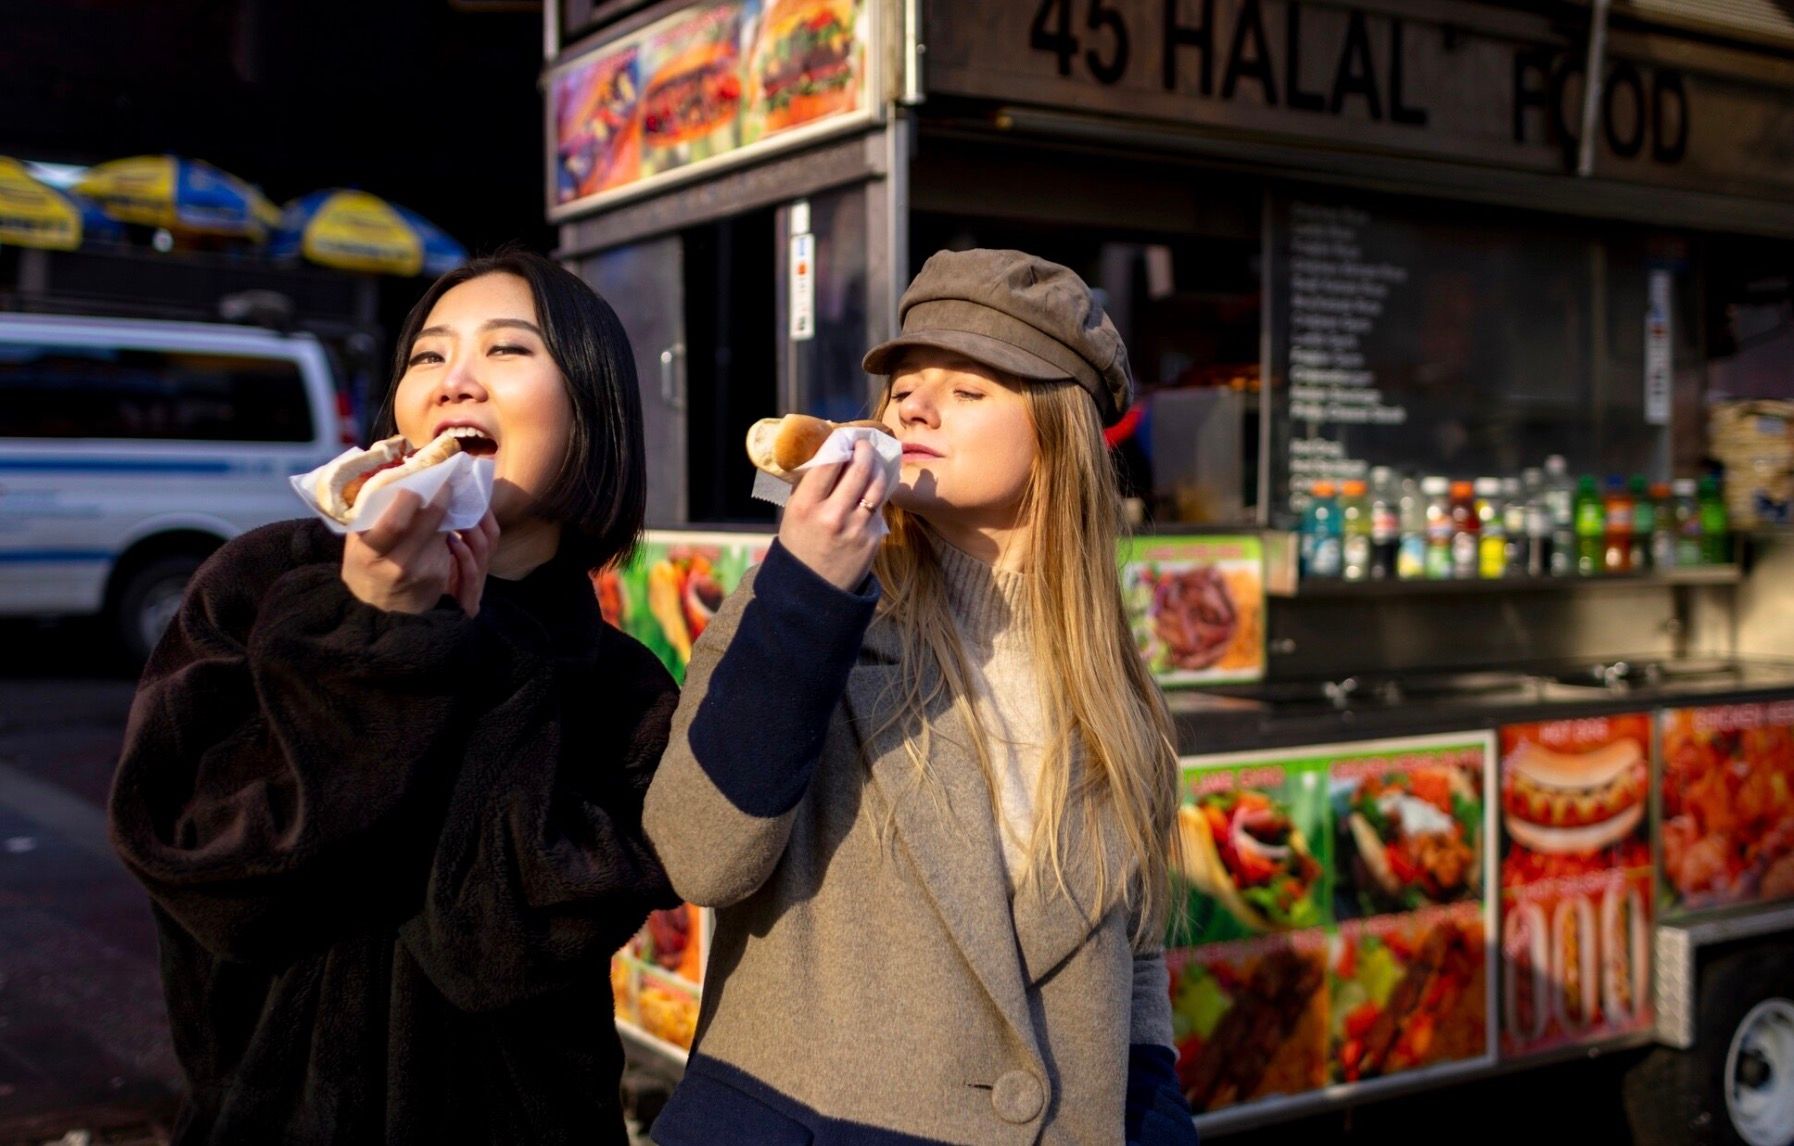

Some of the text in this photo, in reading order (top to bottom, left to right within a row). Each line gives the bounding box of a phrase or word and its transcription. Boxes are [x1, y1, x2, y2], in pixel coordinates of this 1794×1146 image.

[1030, 0, 1689, 163] 45 HALAL FOOD
